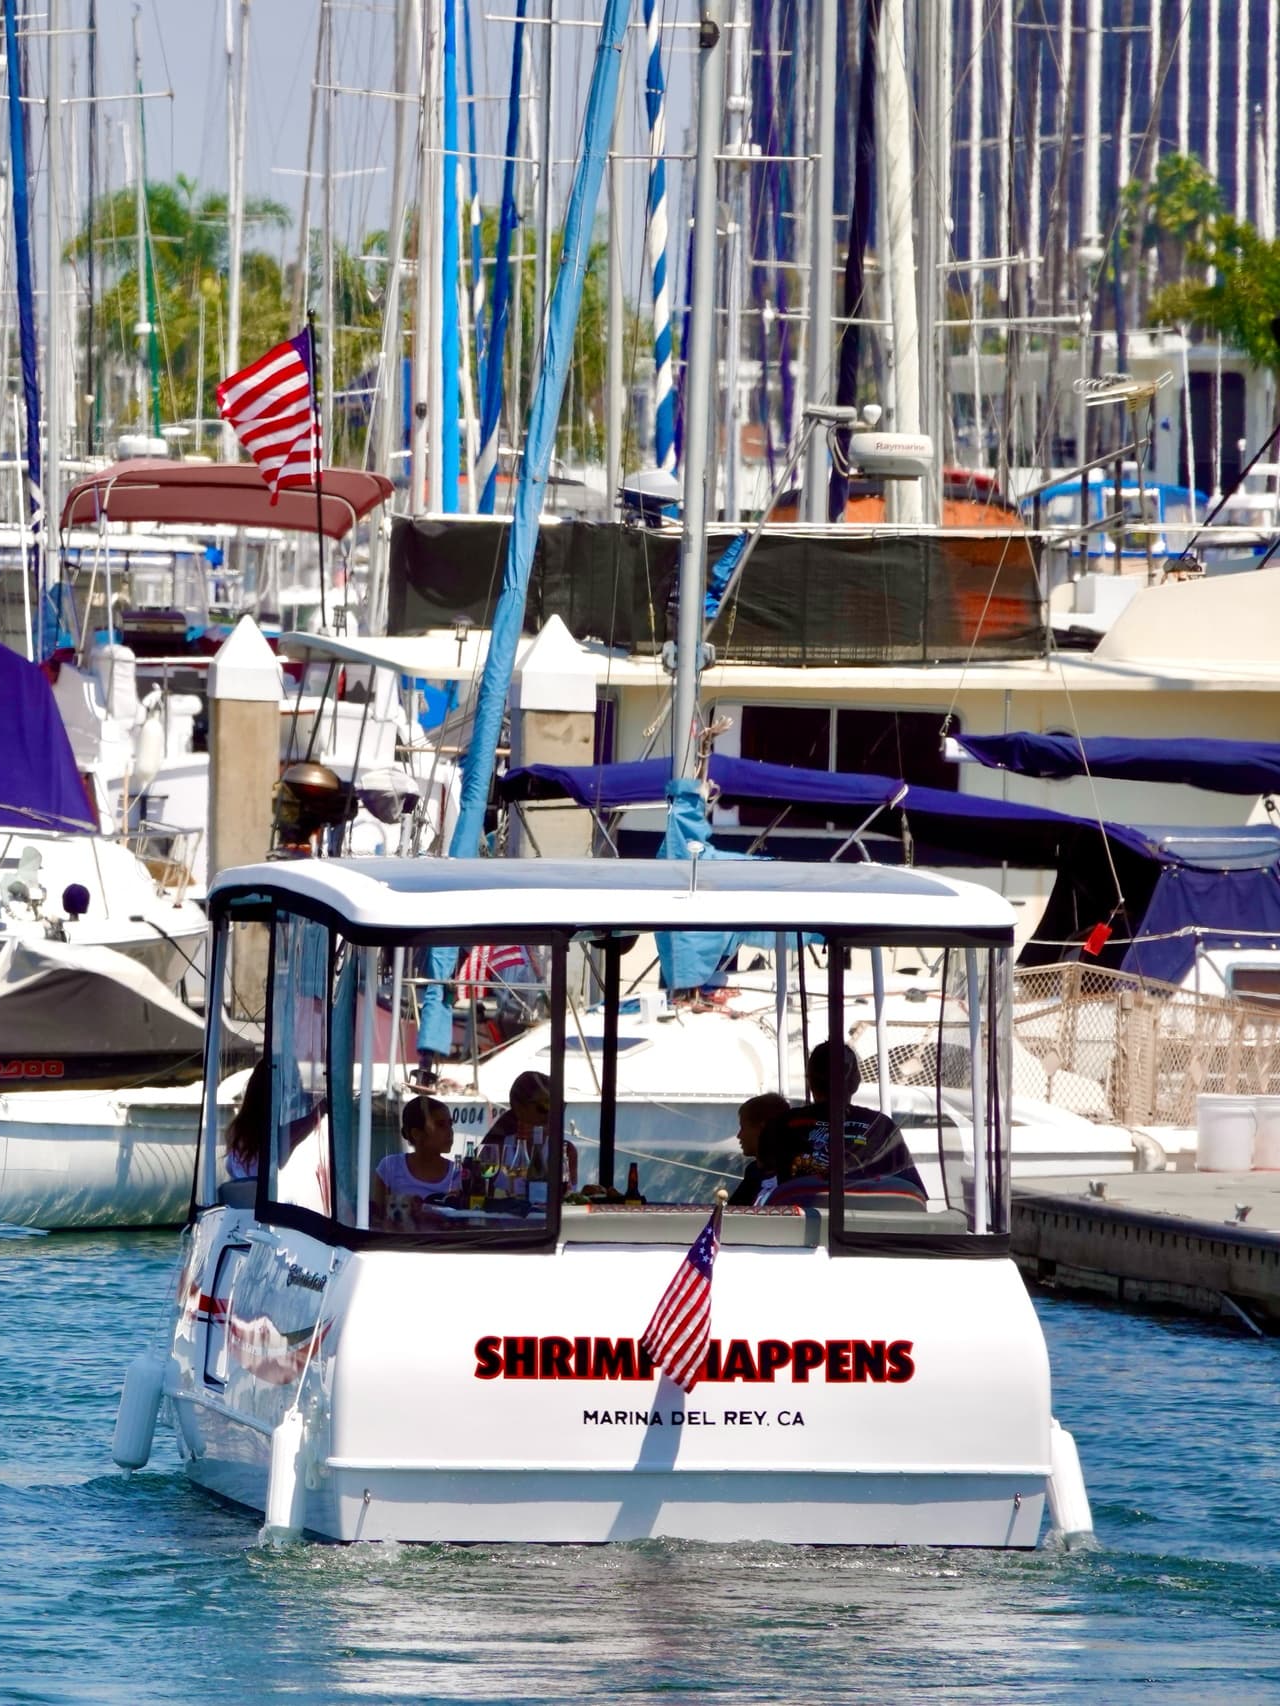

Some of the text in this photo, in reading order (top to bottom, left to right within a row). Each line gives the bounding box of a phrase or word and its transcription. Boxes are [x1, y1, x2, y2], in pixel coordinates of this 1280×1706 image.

[875, 442, 926, 451] Raymarine
[452, 1107, 485, 1125] 0004
[583, 1410, 663, 1426] MARINA
[671, 1411, 716, 1426] DEL
[777, 1411, 805, 1426] CA
